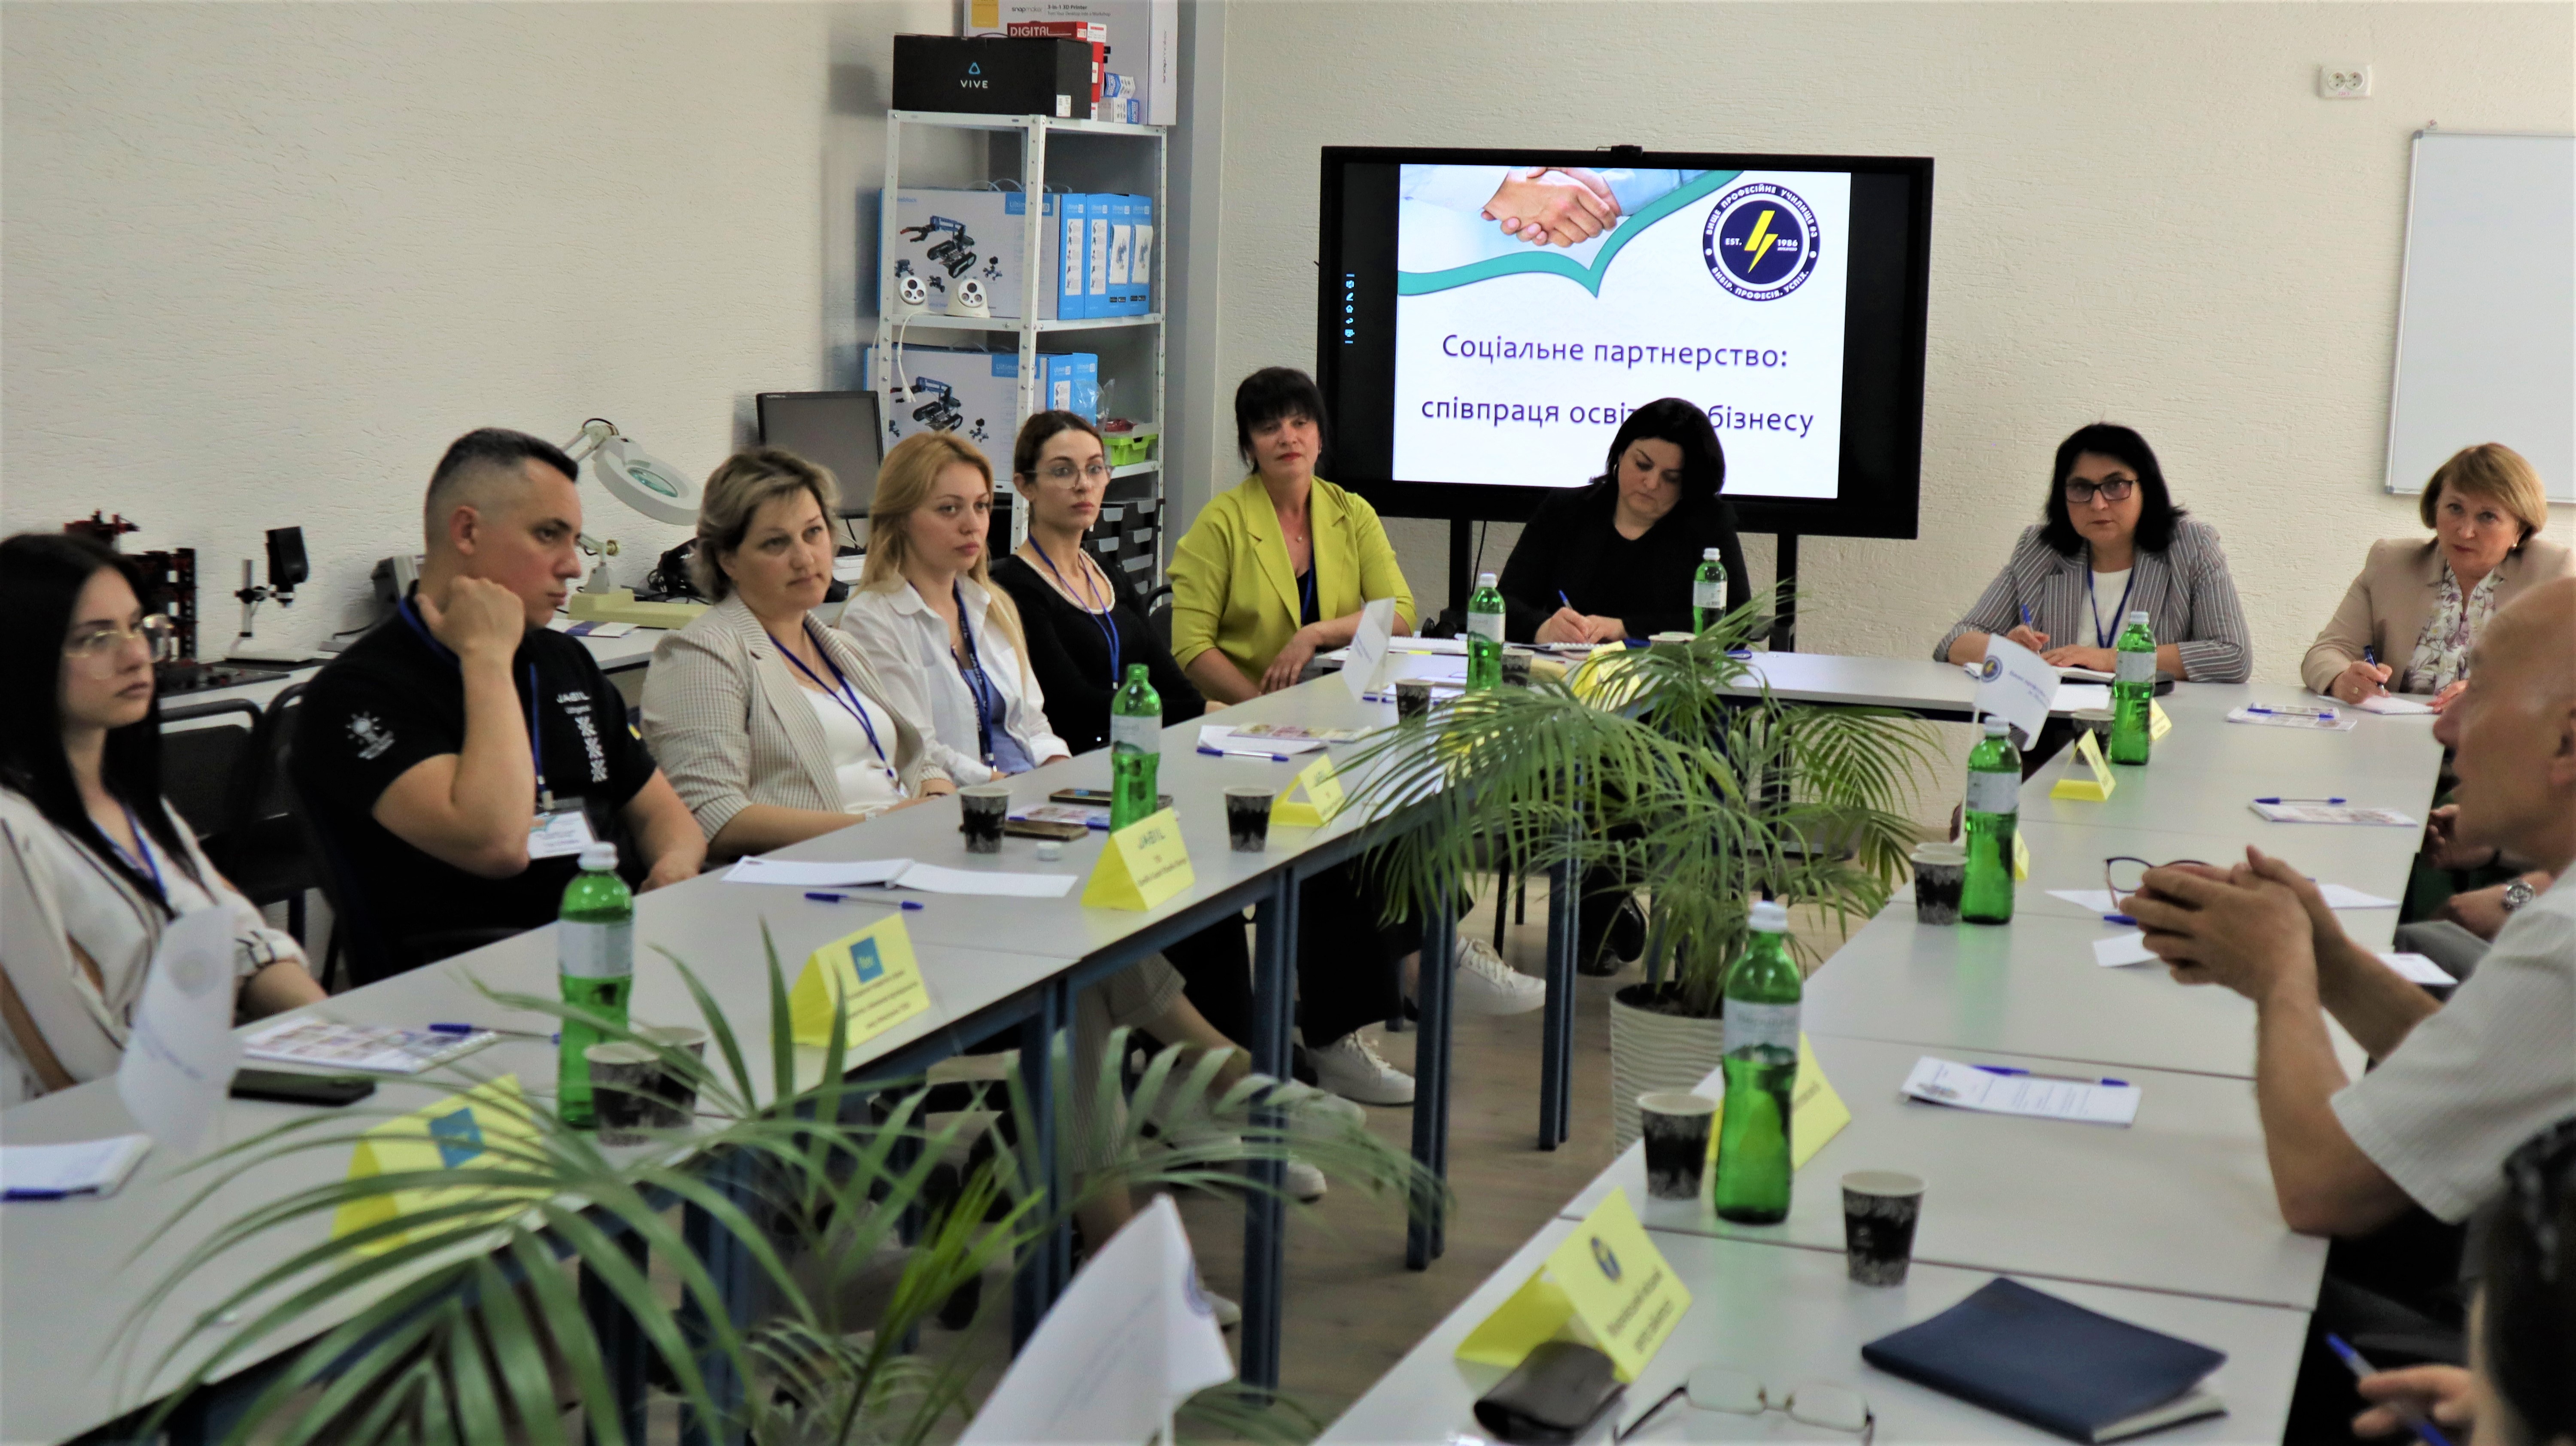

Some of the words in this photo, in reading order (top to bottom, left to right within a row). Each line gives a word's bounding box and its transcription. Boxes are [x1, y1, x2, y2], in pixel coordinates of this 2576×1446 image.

[1010, 26, 1071, 36] DIGITAL
[960, 80, 988, 88] VIVE
[1706, 209, 1722, 235] ВИЩЕ
[1720, 184, 1777, 209] ПРОФЕСІЙНЕ
[1780, 189, 1815, 225] УЧИЛИЩЕ
[1777, 239, 1798, 247] 1986
[1443, 334, 1584, 364] Соціальне
[1594, 343, 1788, 372] партнерство:
[1421, 396, 1559, 428] співпраця
[1707, 405, 1814, 438] бізнесу
[556, 691, 591, 703] JABIL
